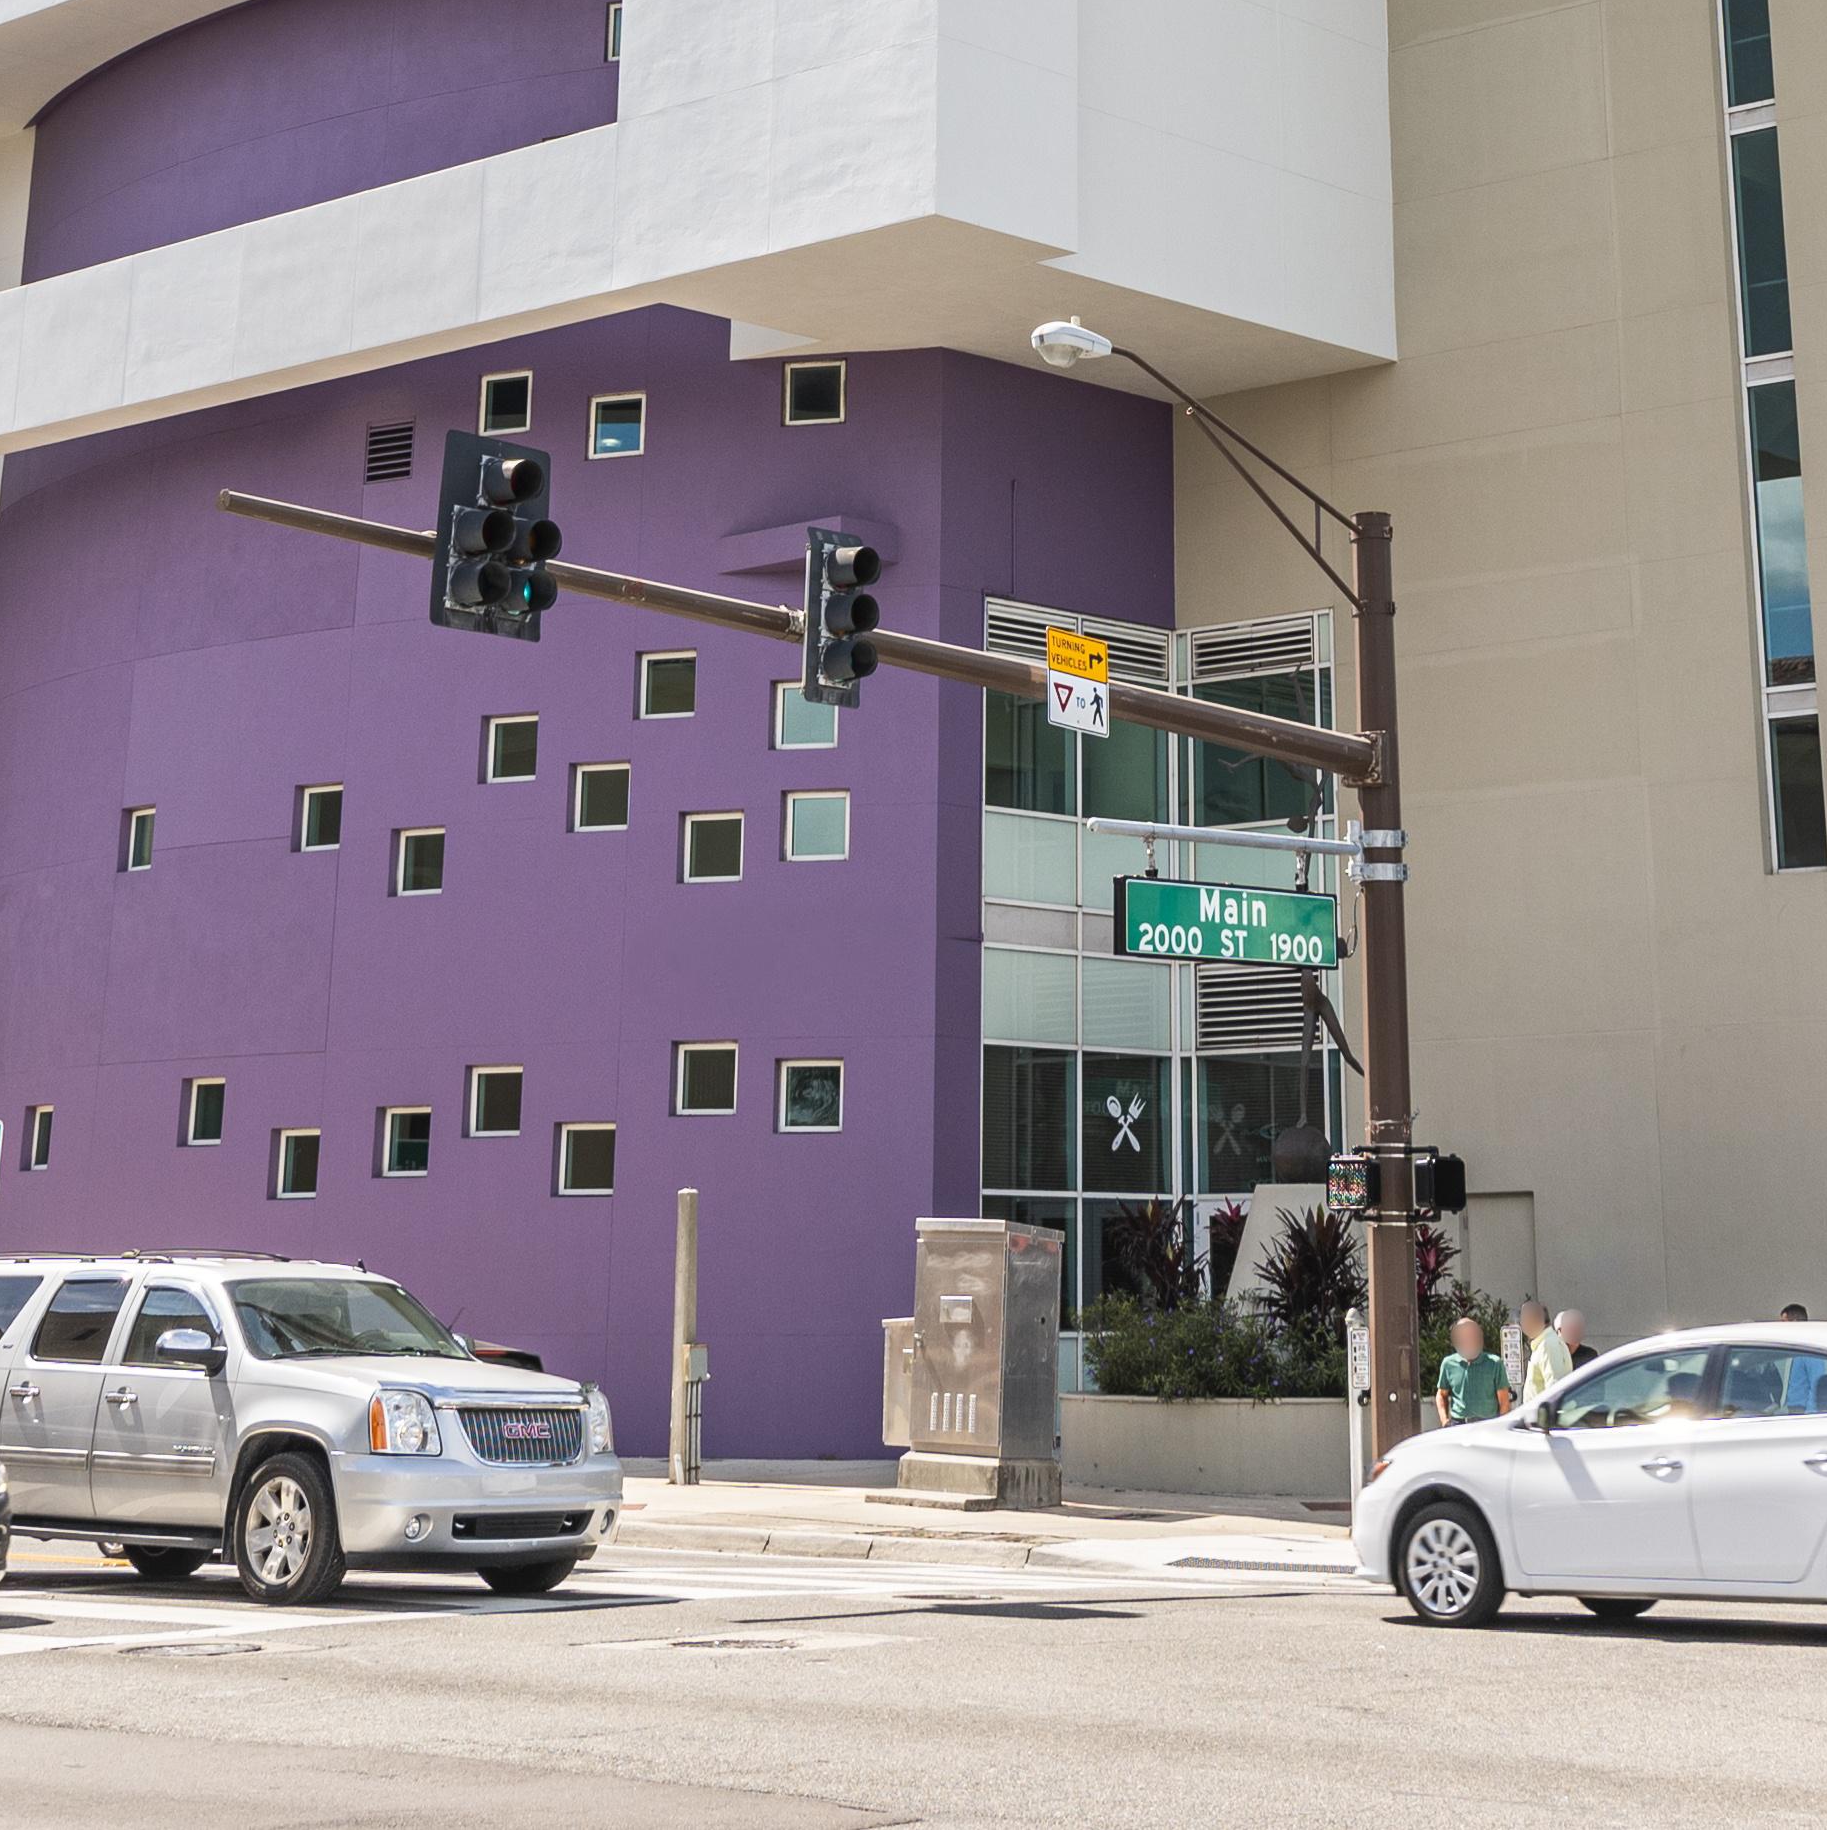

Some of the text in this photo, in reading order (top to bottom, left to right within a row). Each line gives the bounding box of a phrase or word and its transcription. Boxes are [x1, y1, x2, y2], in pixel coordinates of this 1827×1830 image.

[1051, 635, 1086, 655] TURNING
[1051, 652, 1087, 671] VEHICLES
[1076, 696, 1086, 709] TO
[1199, 887, 1267, 927] Main
[1138, 922, 1323, 964] 2000 ST 1900
[503, 1422, 551, 1439] GMC
